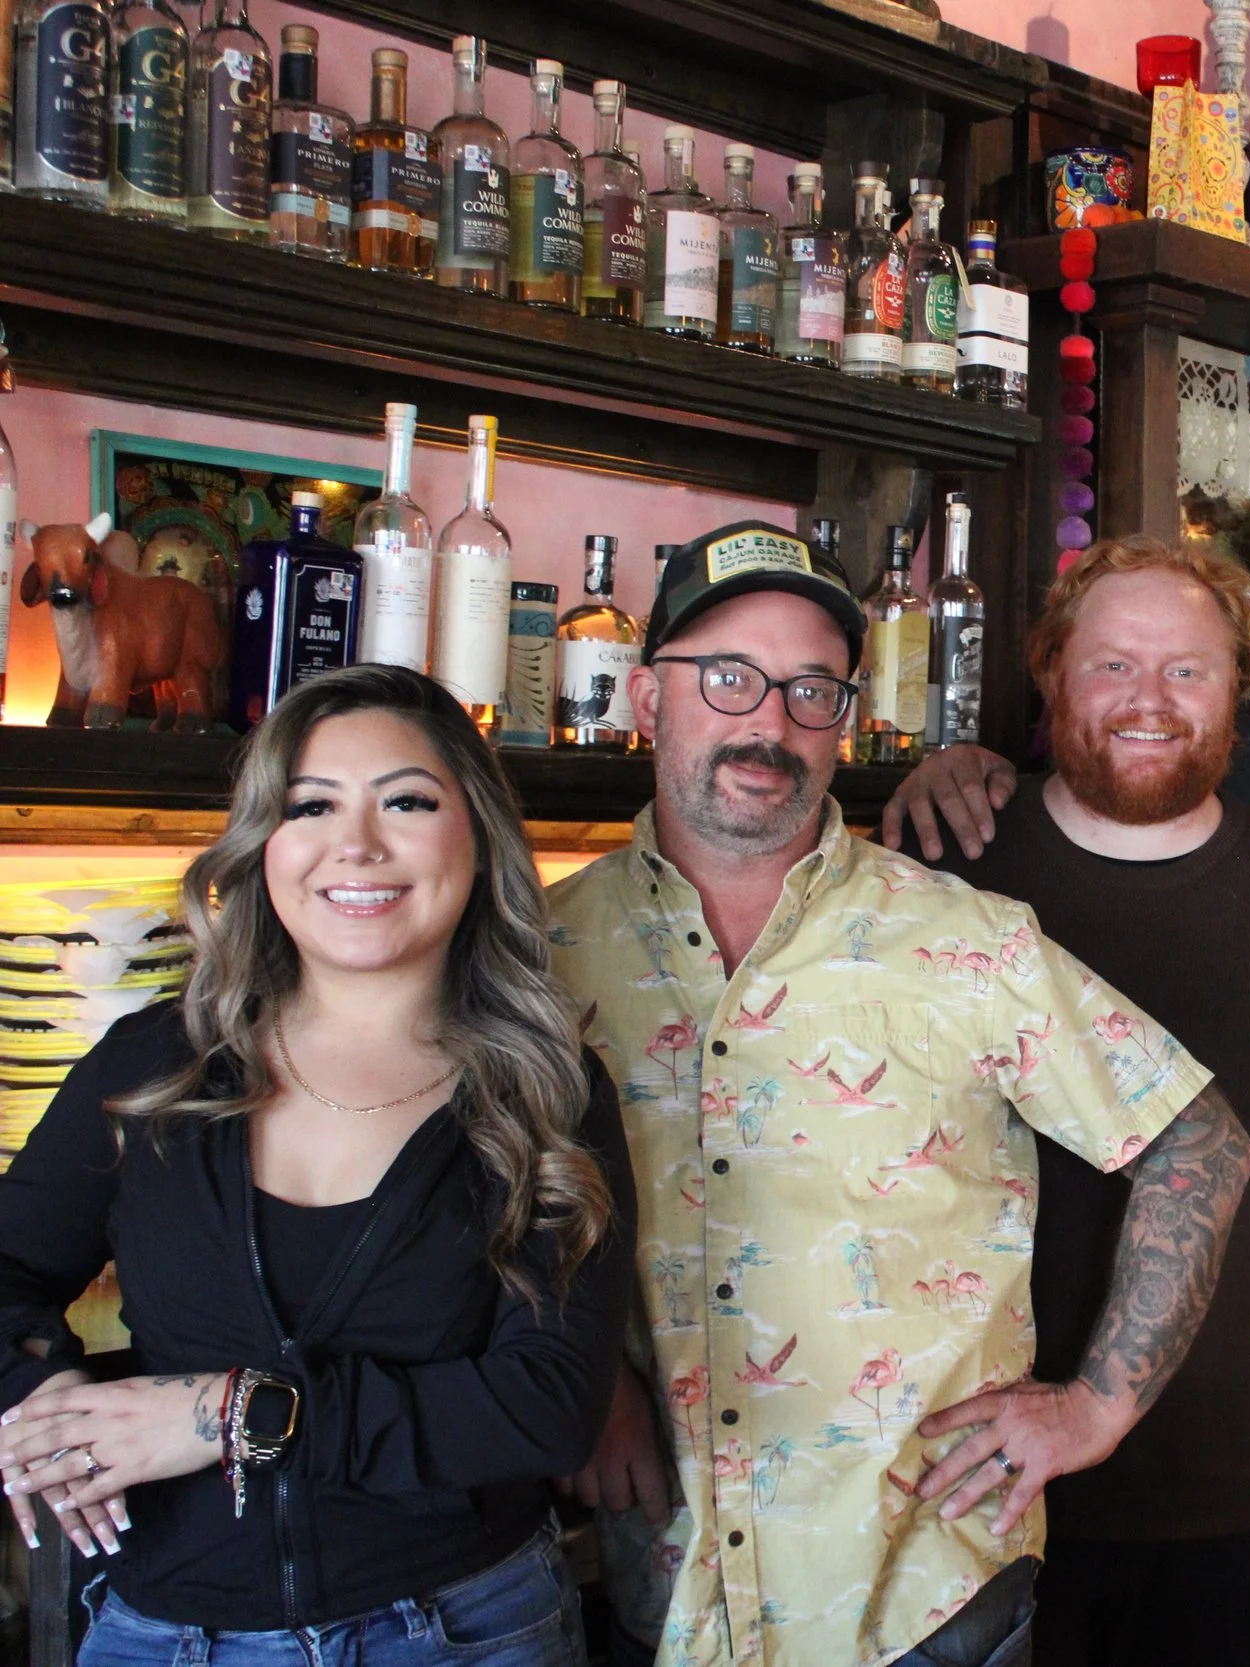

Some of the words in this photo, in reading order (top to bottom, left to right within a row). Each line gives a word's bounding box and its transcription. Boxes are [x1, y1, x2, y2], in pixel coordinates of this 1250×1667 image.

[142, 50, 185, 90] G4
[297, 148, 351, 169] PRIMERO
[391, 167, 440, 186] PRIMERO
[478, 190, 506, 206] WILD
[463, 200, 510, 218] COMMO
[557, 207, 582, 224] WILD
[542, 217, 584, 236] COMMO
[998, 351, 1017, 362] LALO
[754, 537, 799, 553] EASY
[719, 549, 755, 564] CAJUN
[758, 549, 801, 562] GARAGE
[310, 615, 332, 628] DON
[300, 627, 341, 642] FULANO
